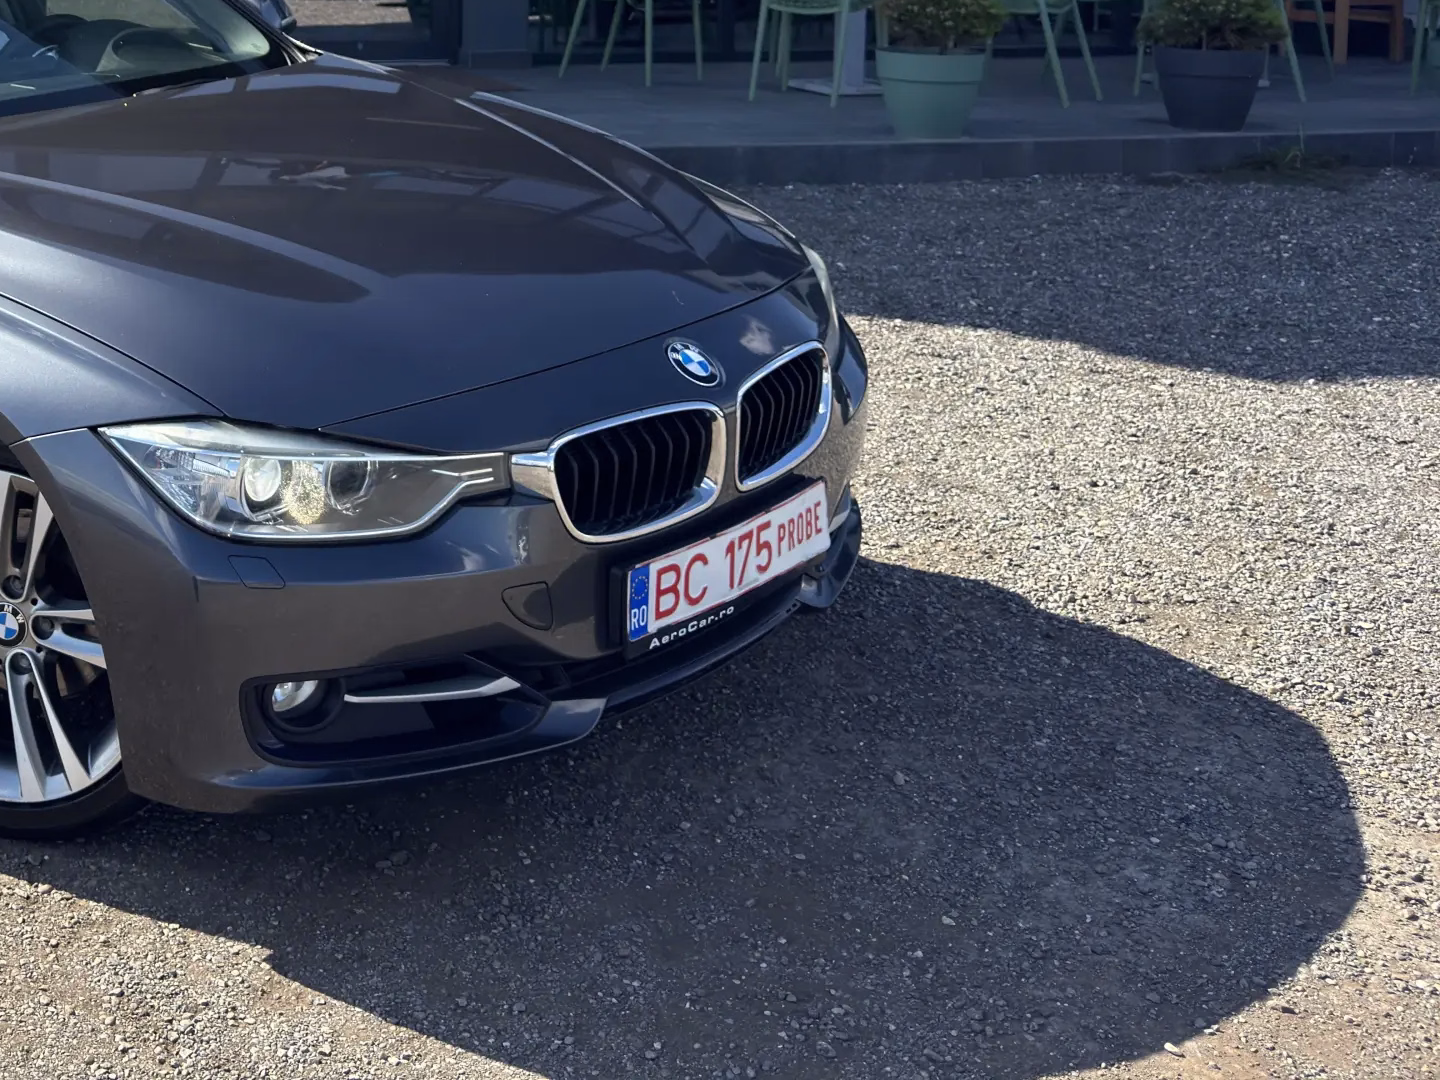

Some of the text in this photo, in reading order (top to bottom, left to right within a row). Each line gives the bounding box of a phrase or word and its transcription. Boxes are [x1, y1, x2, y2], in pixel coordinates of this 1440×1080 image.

[654, 501, 823, 621] BC 175 PROBE
[631, 605, 648, 631] RO
[648, 605, 736, 650] AeroCar.ro
